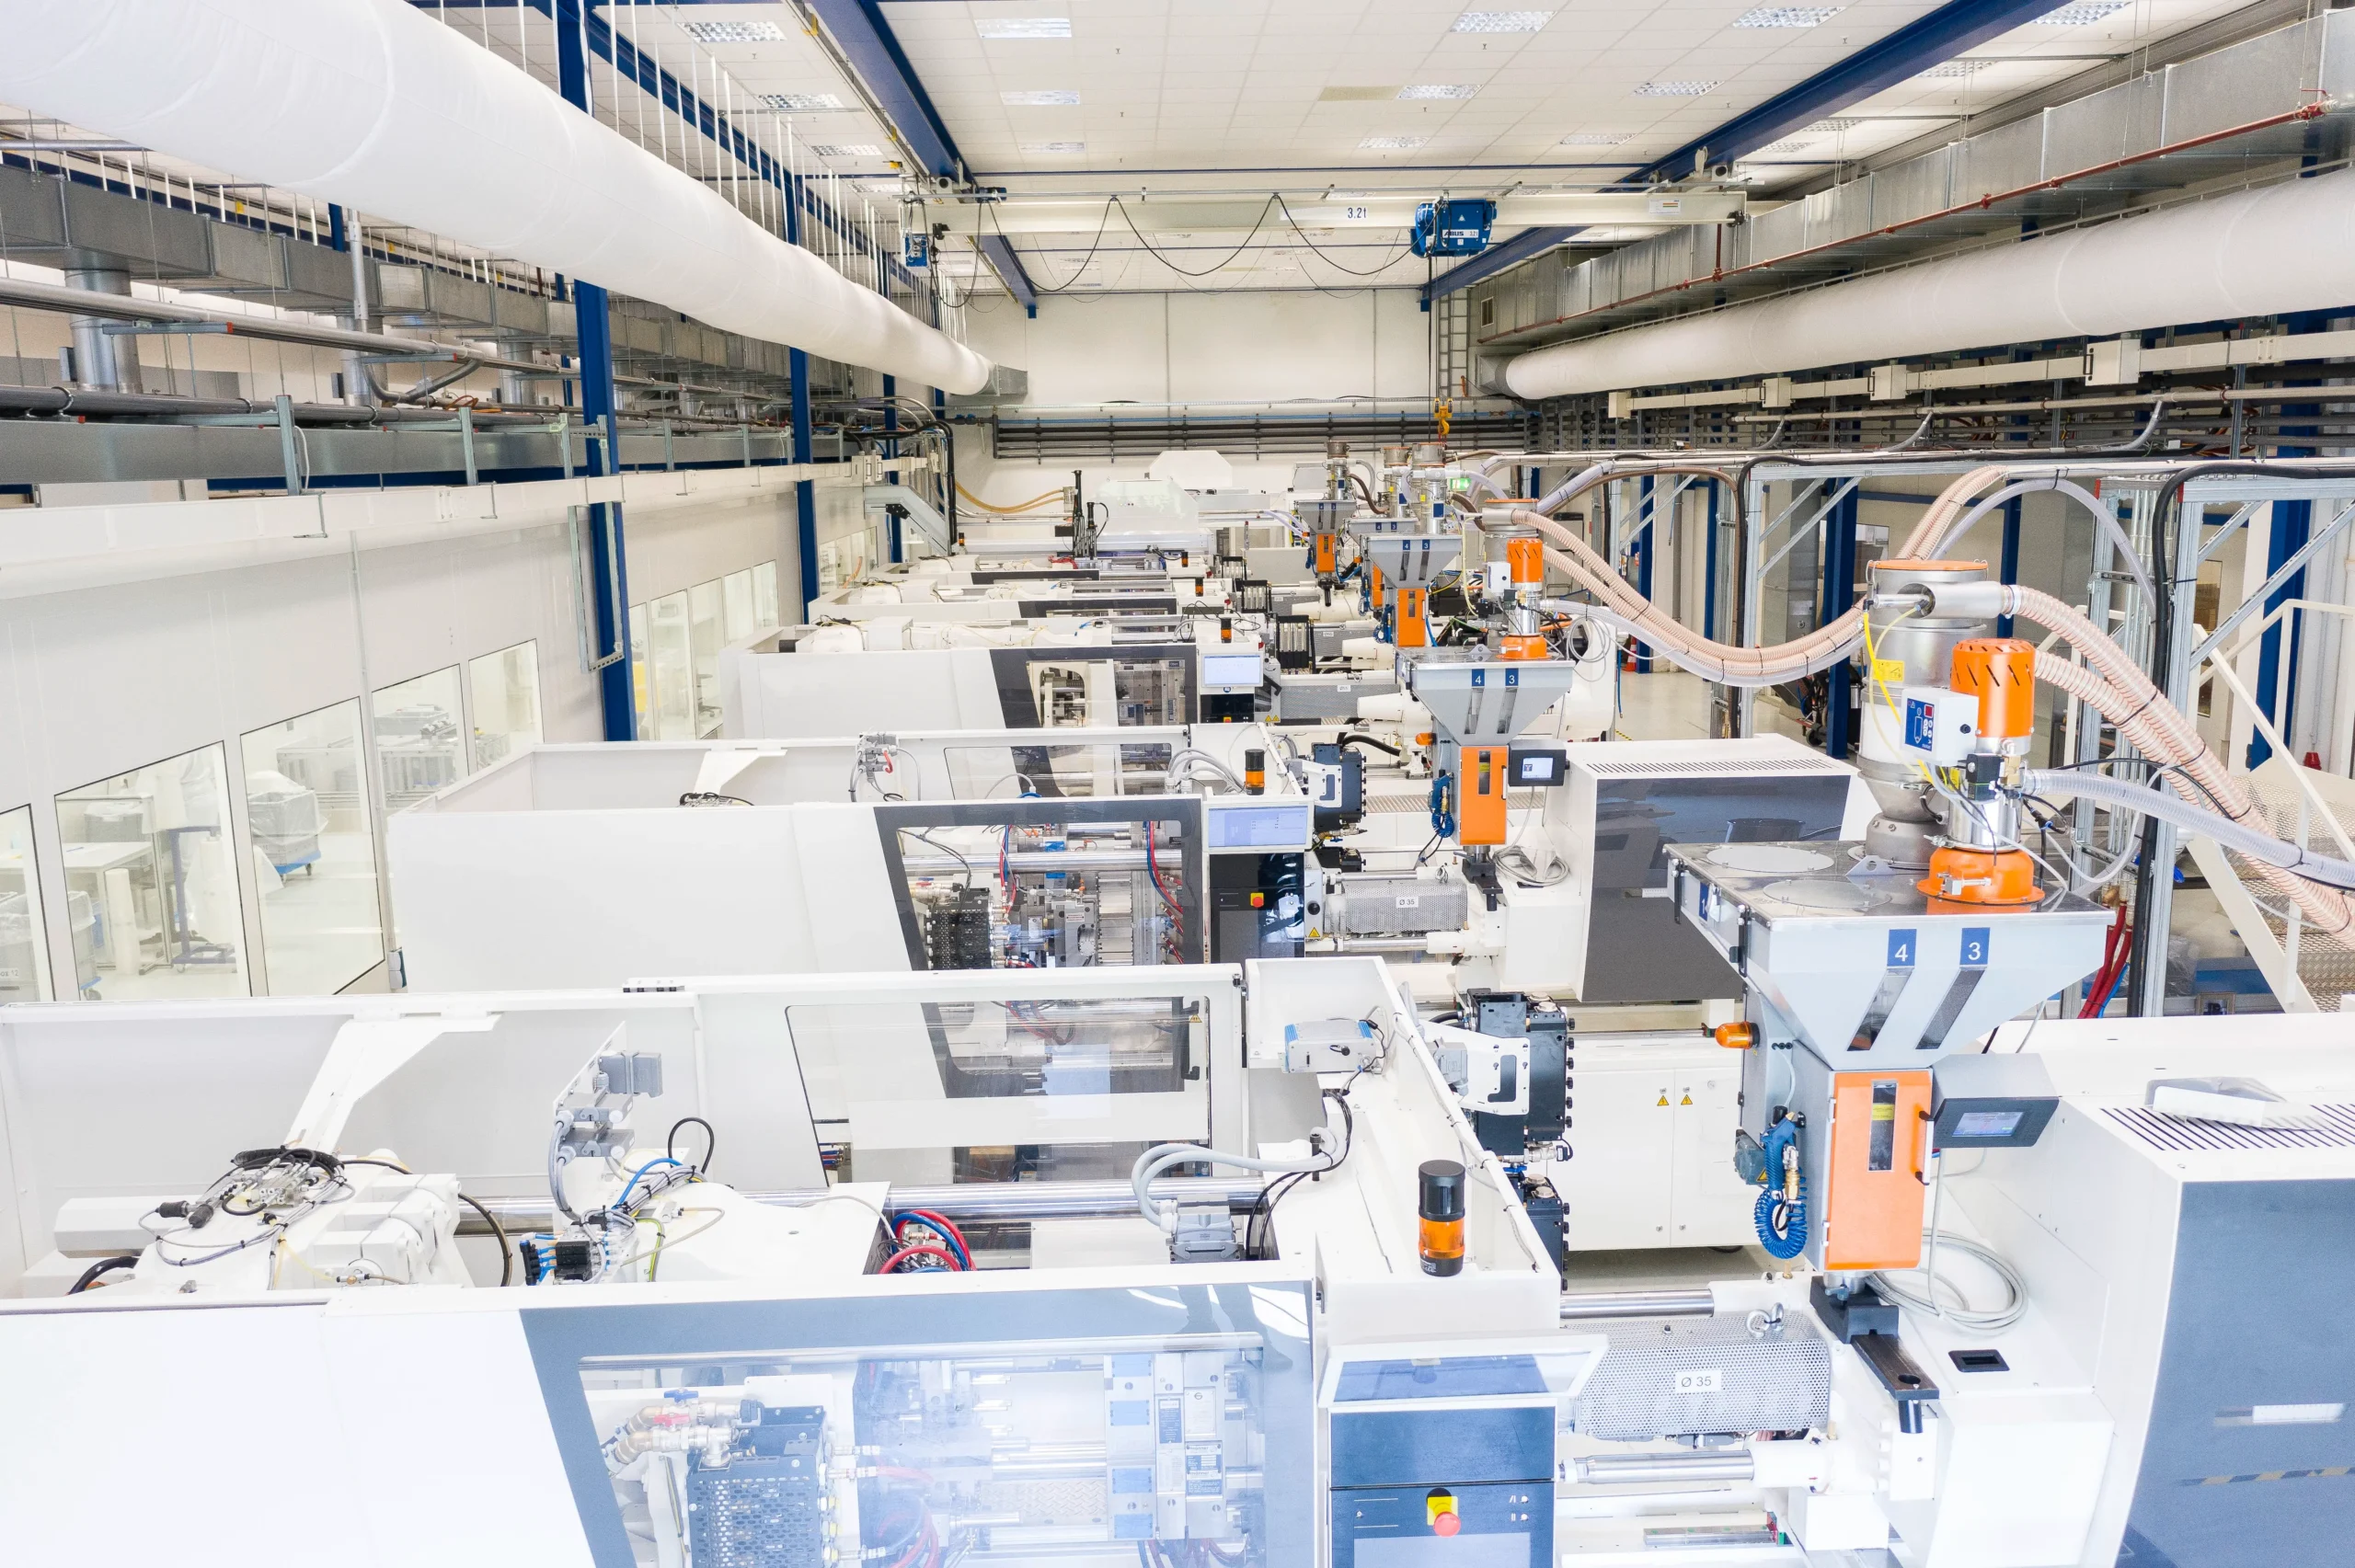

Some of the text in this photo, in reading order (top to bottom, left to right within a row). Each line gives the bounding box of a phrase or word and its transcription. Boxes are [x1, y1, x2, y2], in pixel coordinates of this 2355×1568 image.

[1348, 207, 1366, 219] 3.2t
[1475, 674, 1515, 684] 4 3
[1895, 942, 1981, 962] 4 3
[1696, 1376, 1712, 1387] 35
